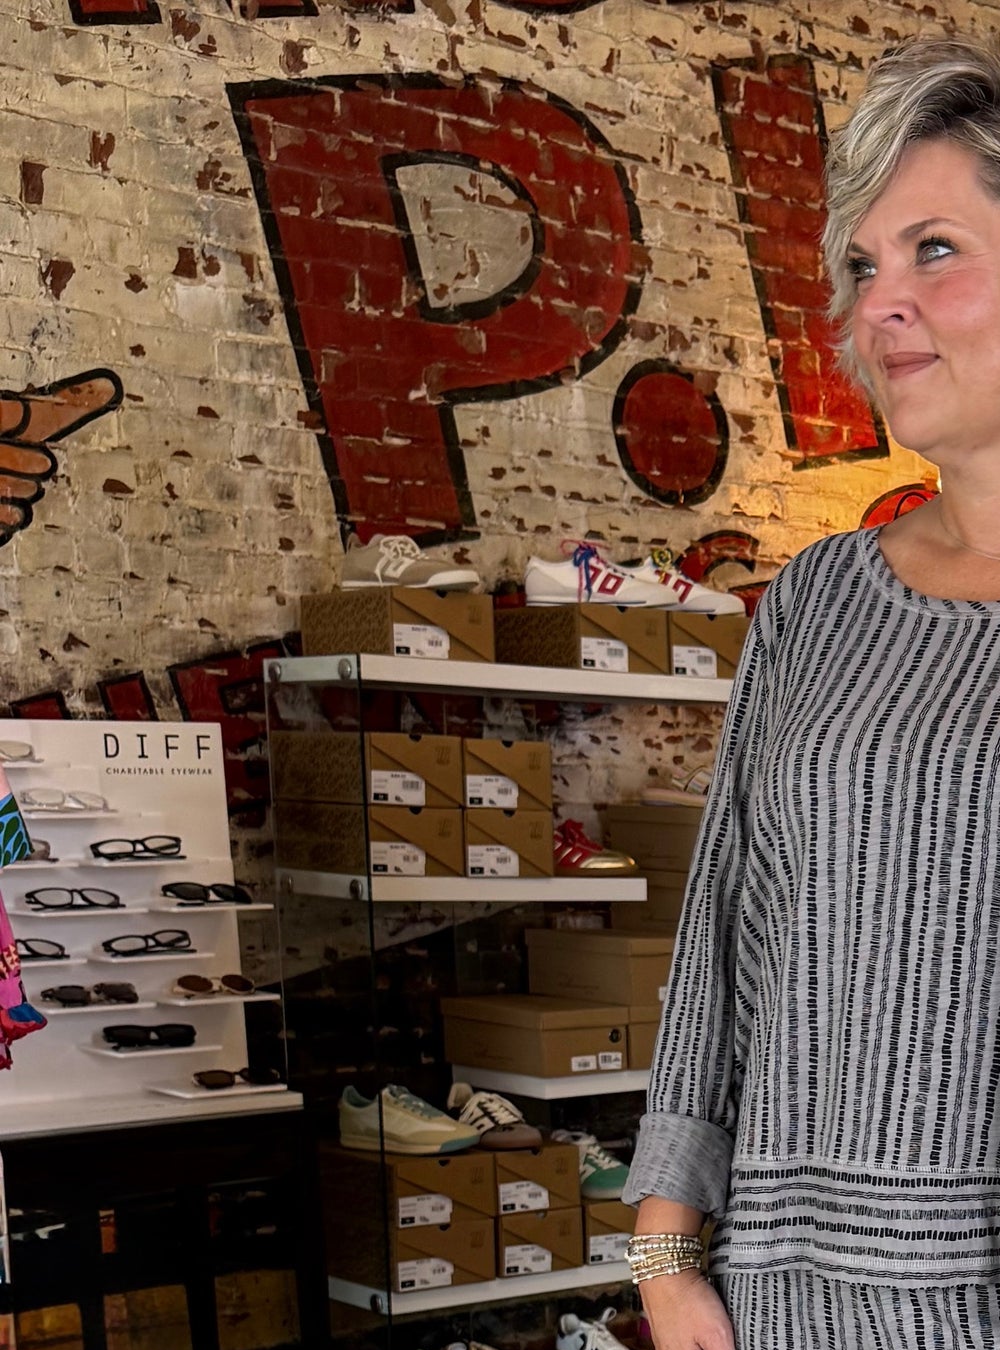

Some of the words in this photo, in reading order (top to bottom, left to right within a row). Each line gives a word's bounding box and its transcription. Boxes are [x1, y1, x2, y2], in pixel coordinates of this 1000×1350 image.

[103, 732, 211, 760] DIFF
[105, 766, 165, 776] CHARITABLE
[171, 767, 213, 776] EYEWEAR
